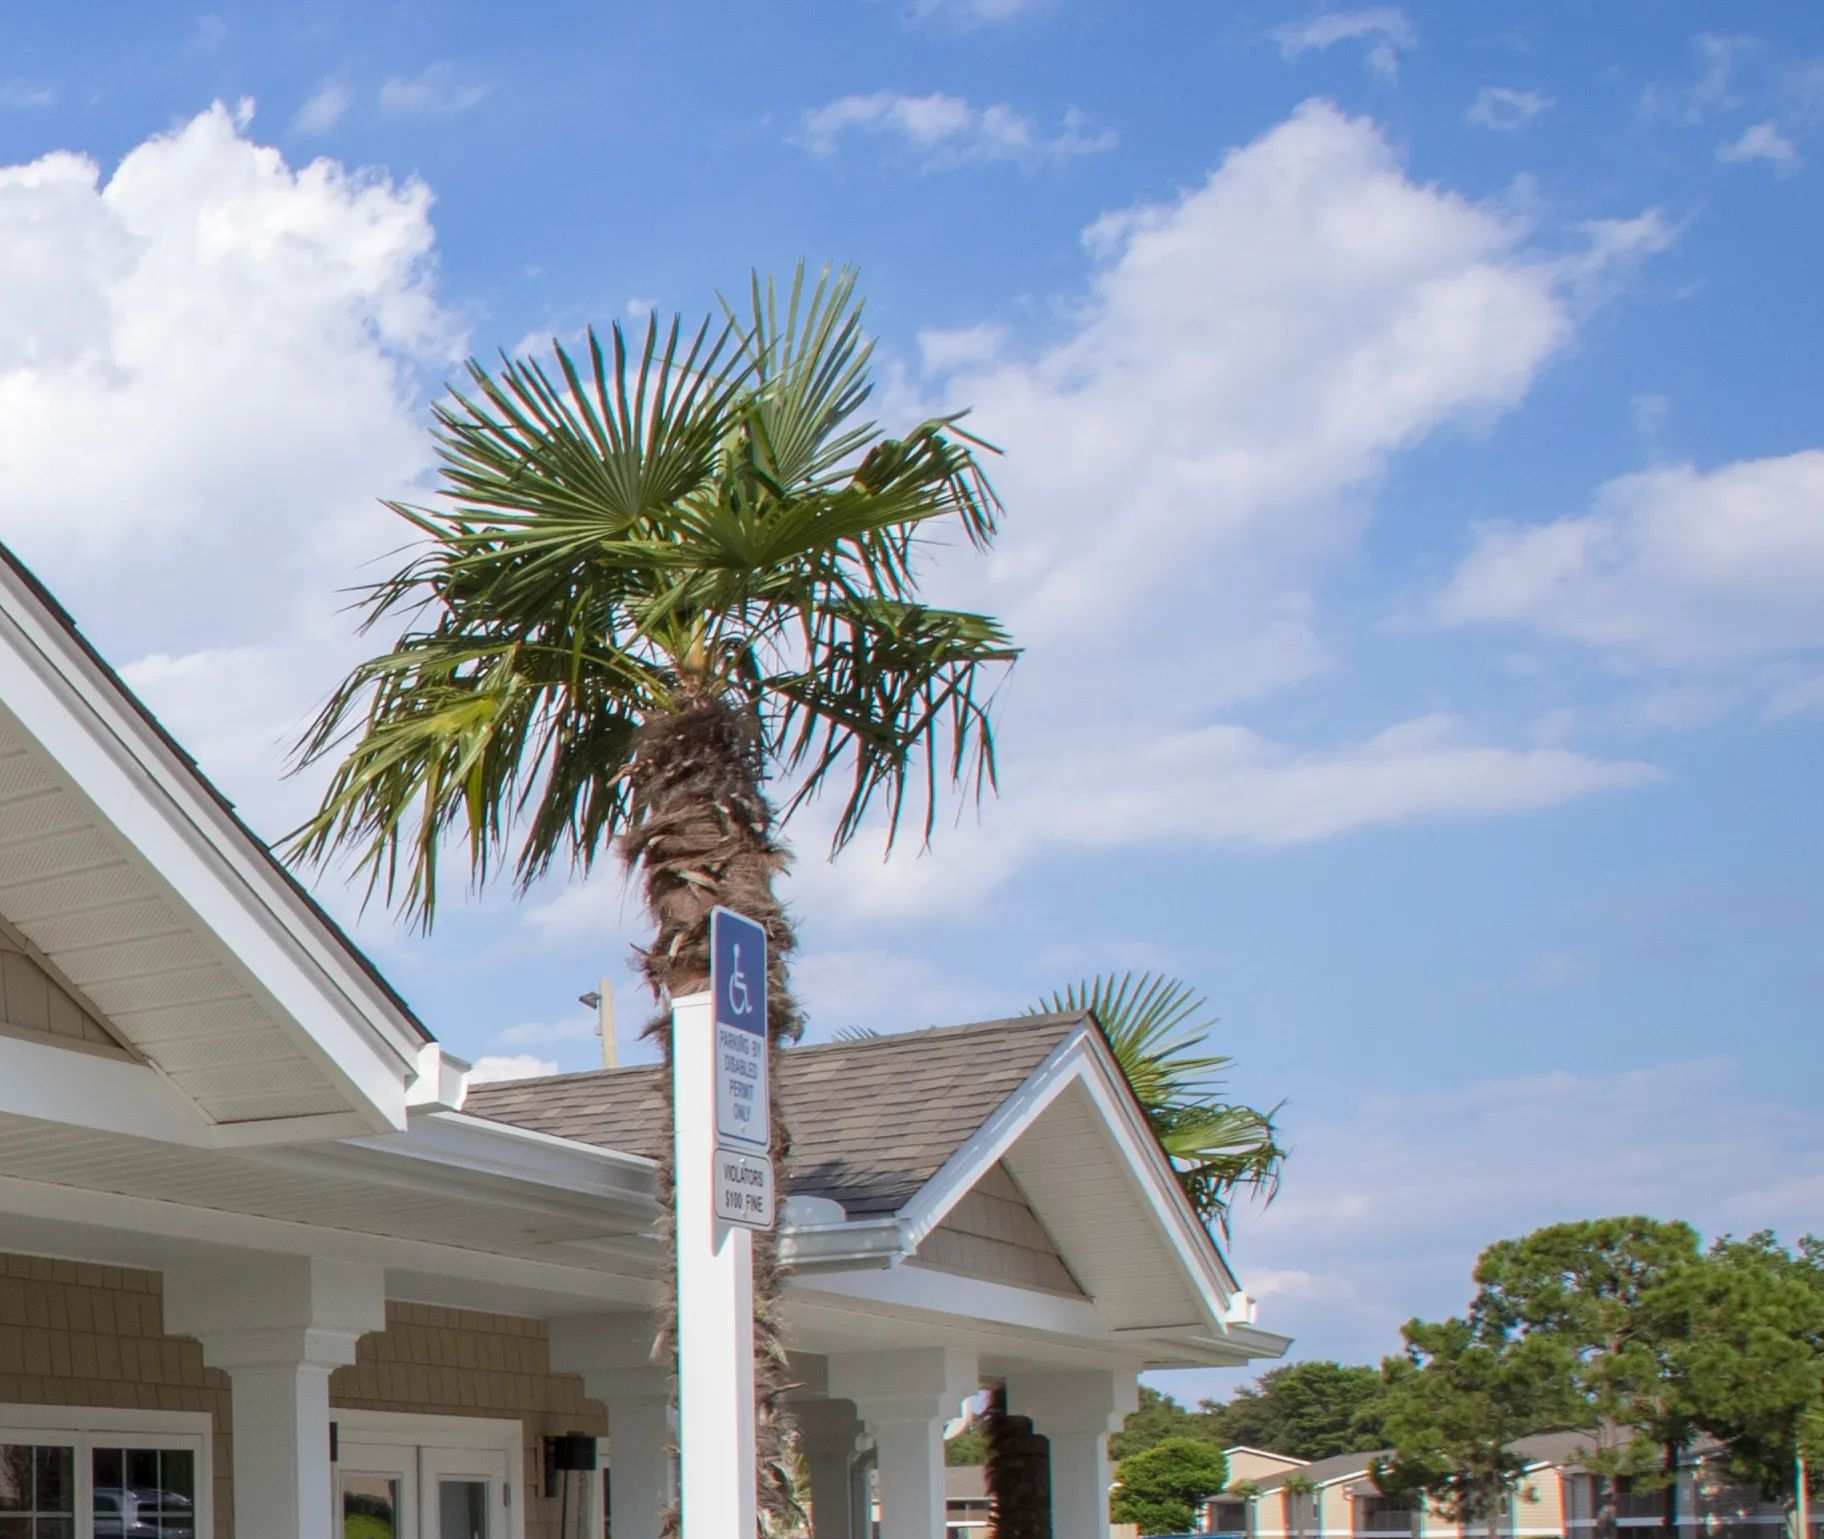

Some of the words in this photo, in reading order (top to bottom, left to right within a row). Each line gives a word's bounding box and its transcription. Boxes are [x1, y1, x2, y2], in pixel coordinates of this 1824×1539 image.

[724, 1054, 757, 1080] DISABLED
[724, 1163, 764, 1187] VIOLATORS
[746, 1193, 764, 1213] FINE
